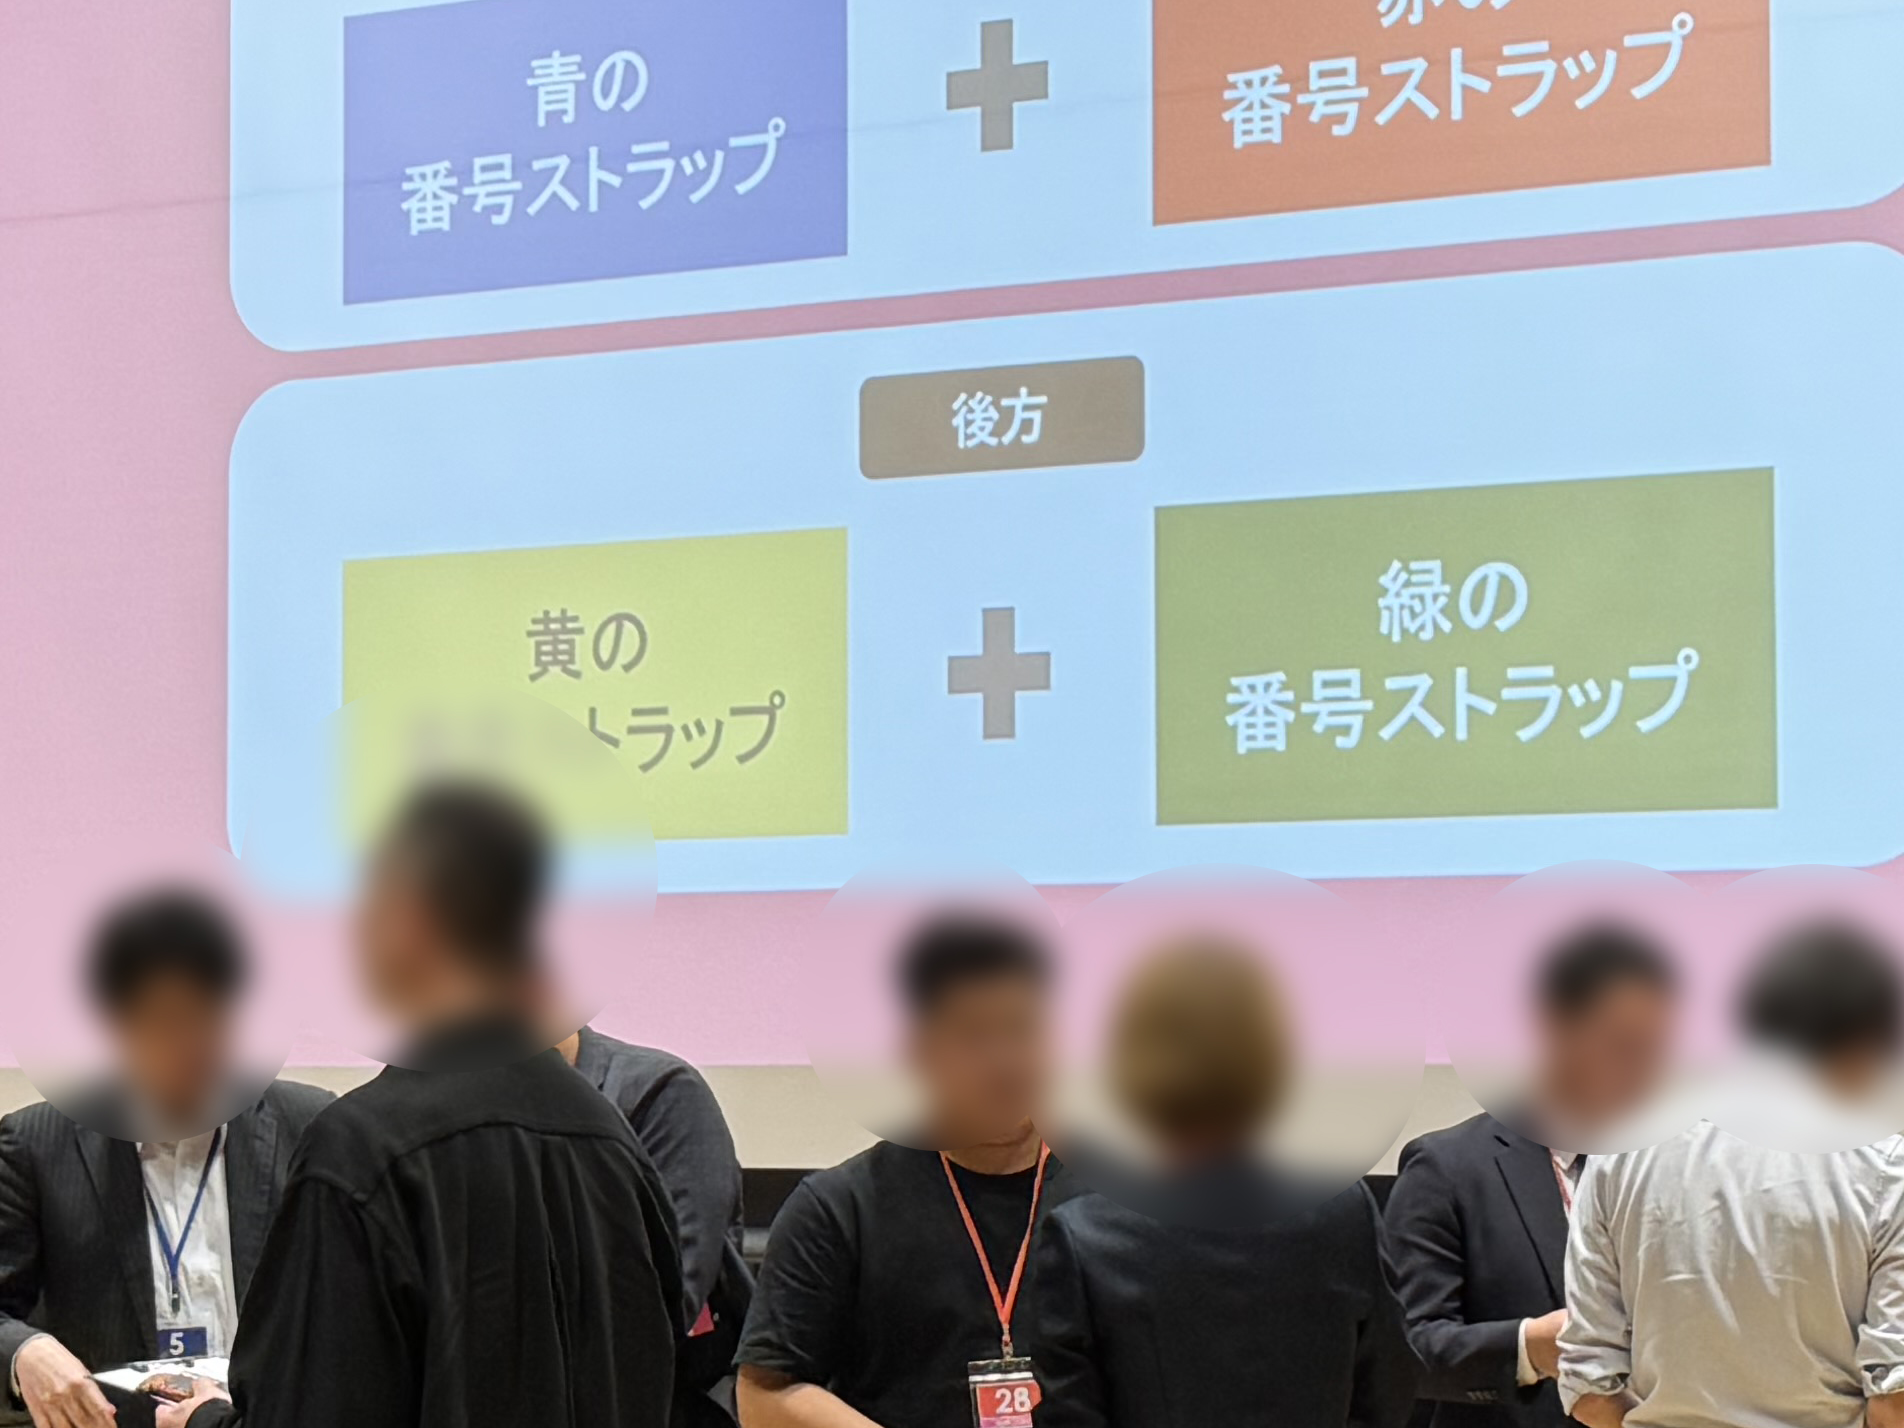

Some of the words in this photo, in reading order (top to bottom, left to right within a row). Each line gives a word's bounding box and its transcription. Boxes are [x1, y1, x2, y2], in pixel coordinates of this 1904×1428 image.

[526, 49, 649, 127] 青の
[1222, 12, 1694, 149] 番号ストラップ
[401, 117, 786, 236] 番号ストラップ
[951, 386, 1048, 449] 後方
[1377, 560, 1529, 643] 緑の
[526, 608, 648, 683] 黄の
[1225, 647, 1699, 754] 番号ストラップ
[169, 1332, 184, 1356] 5
[994, 1387, 1031, 1413] 28
